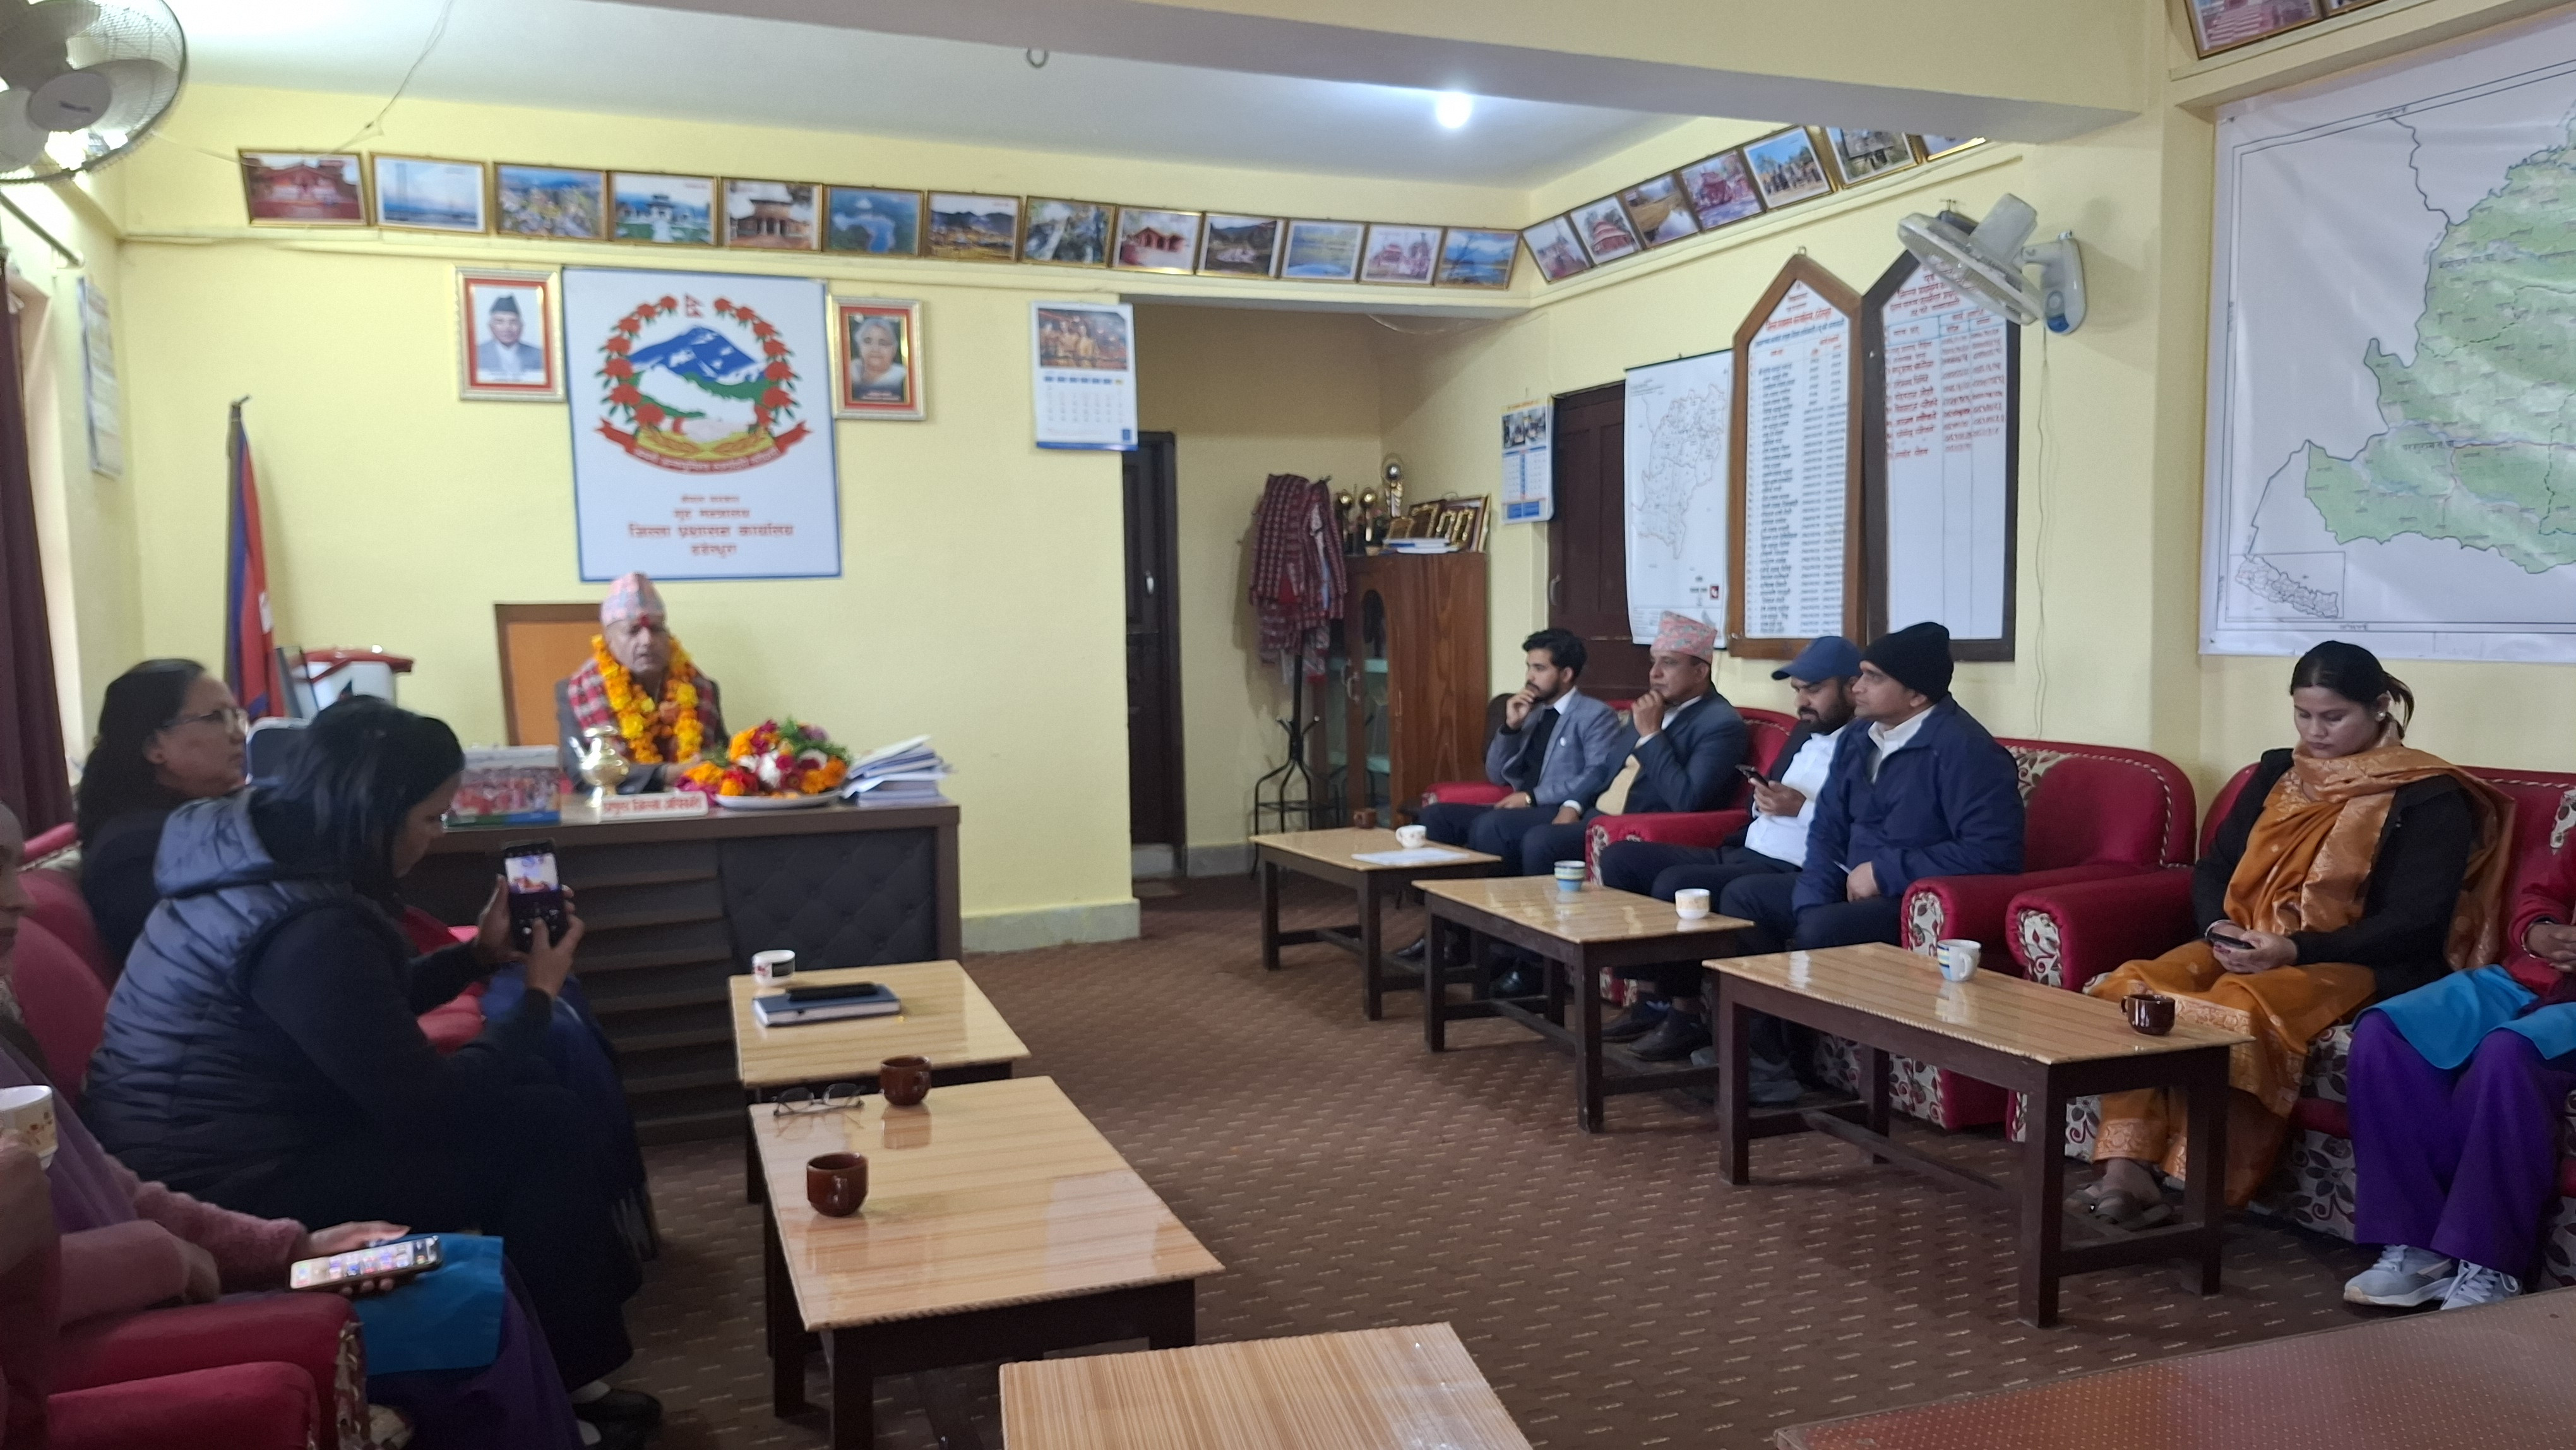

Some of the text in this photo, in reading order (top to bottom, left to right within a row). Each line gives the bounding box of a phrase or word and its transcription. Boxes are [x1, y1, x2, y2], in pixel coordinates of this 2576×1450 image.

[629, 523, 794, 537] जिल्ला प्रशासन कार्यालय
